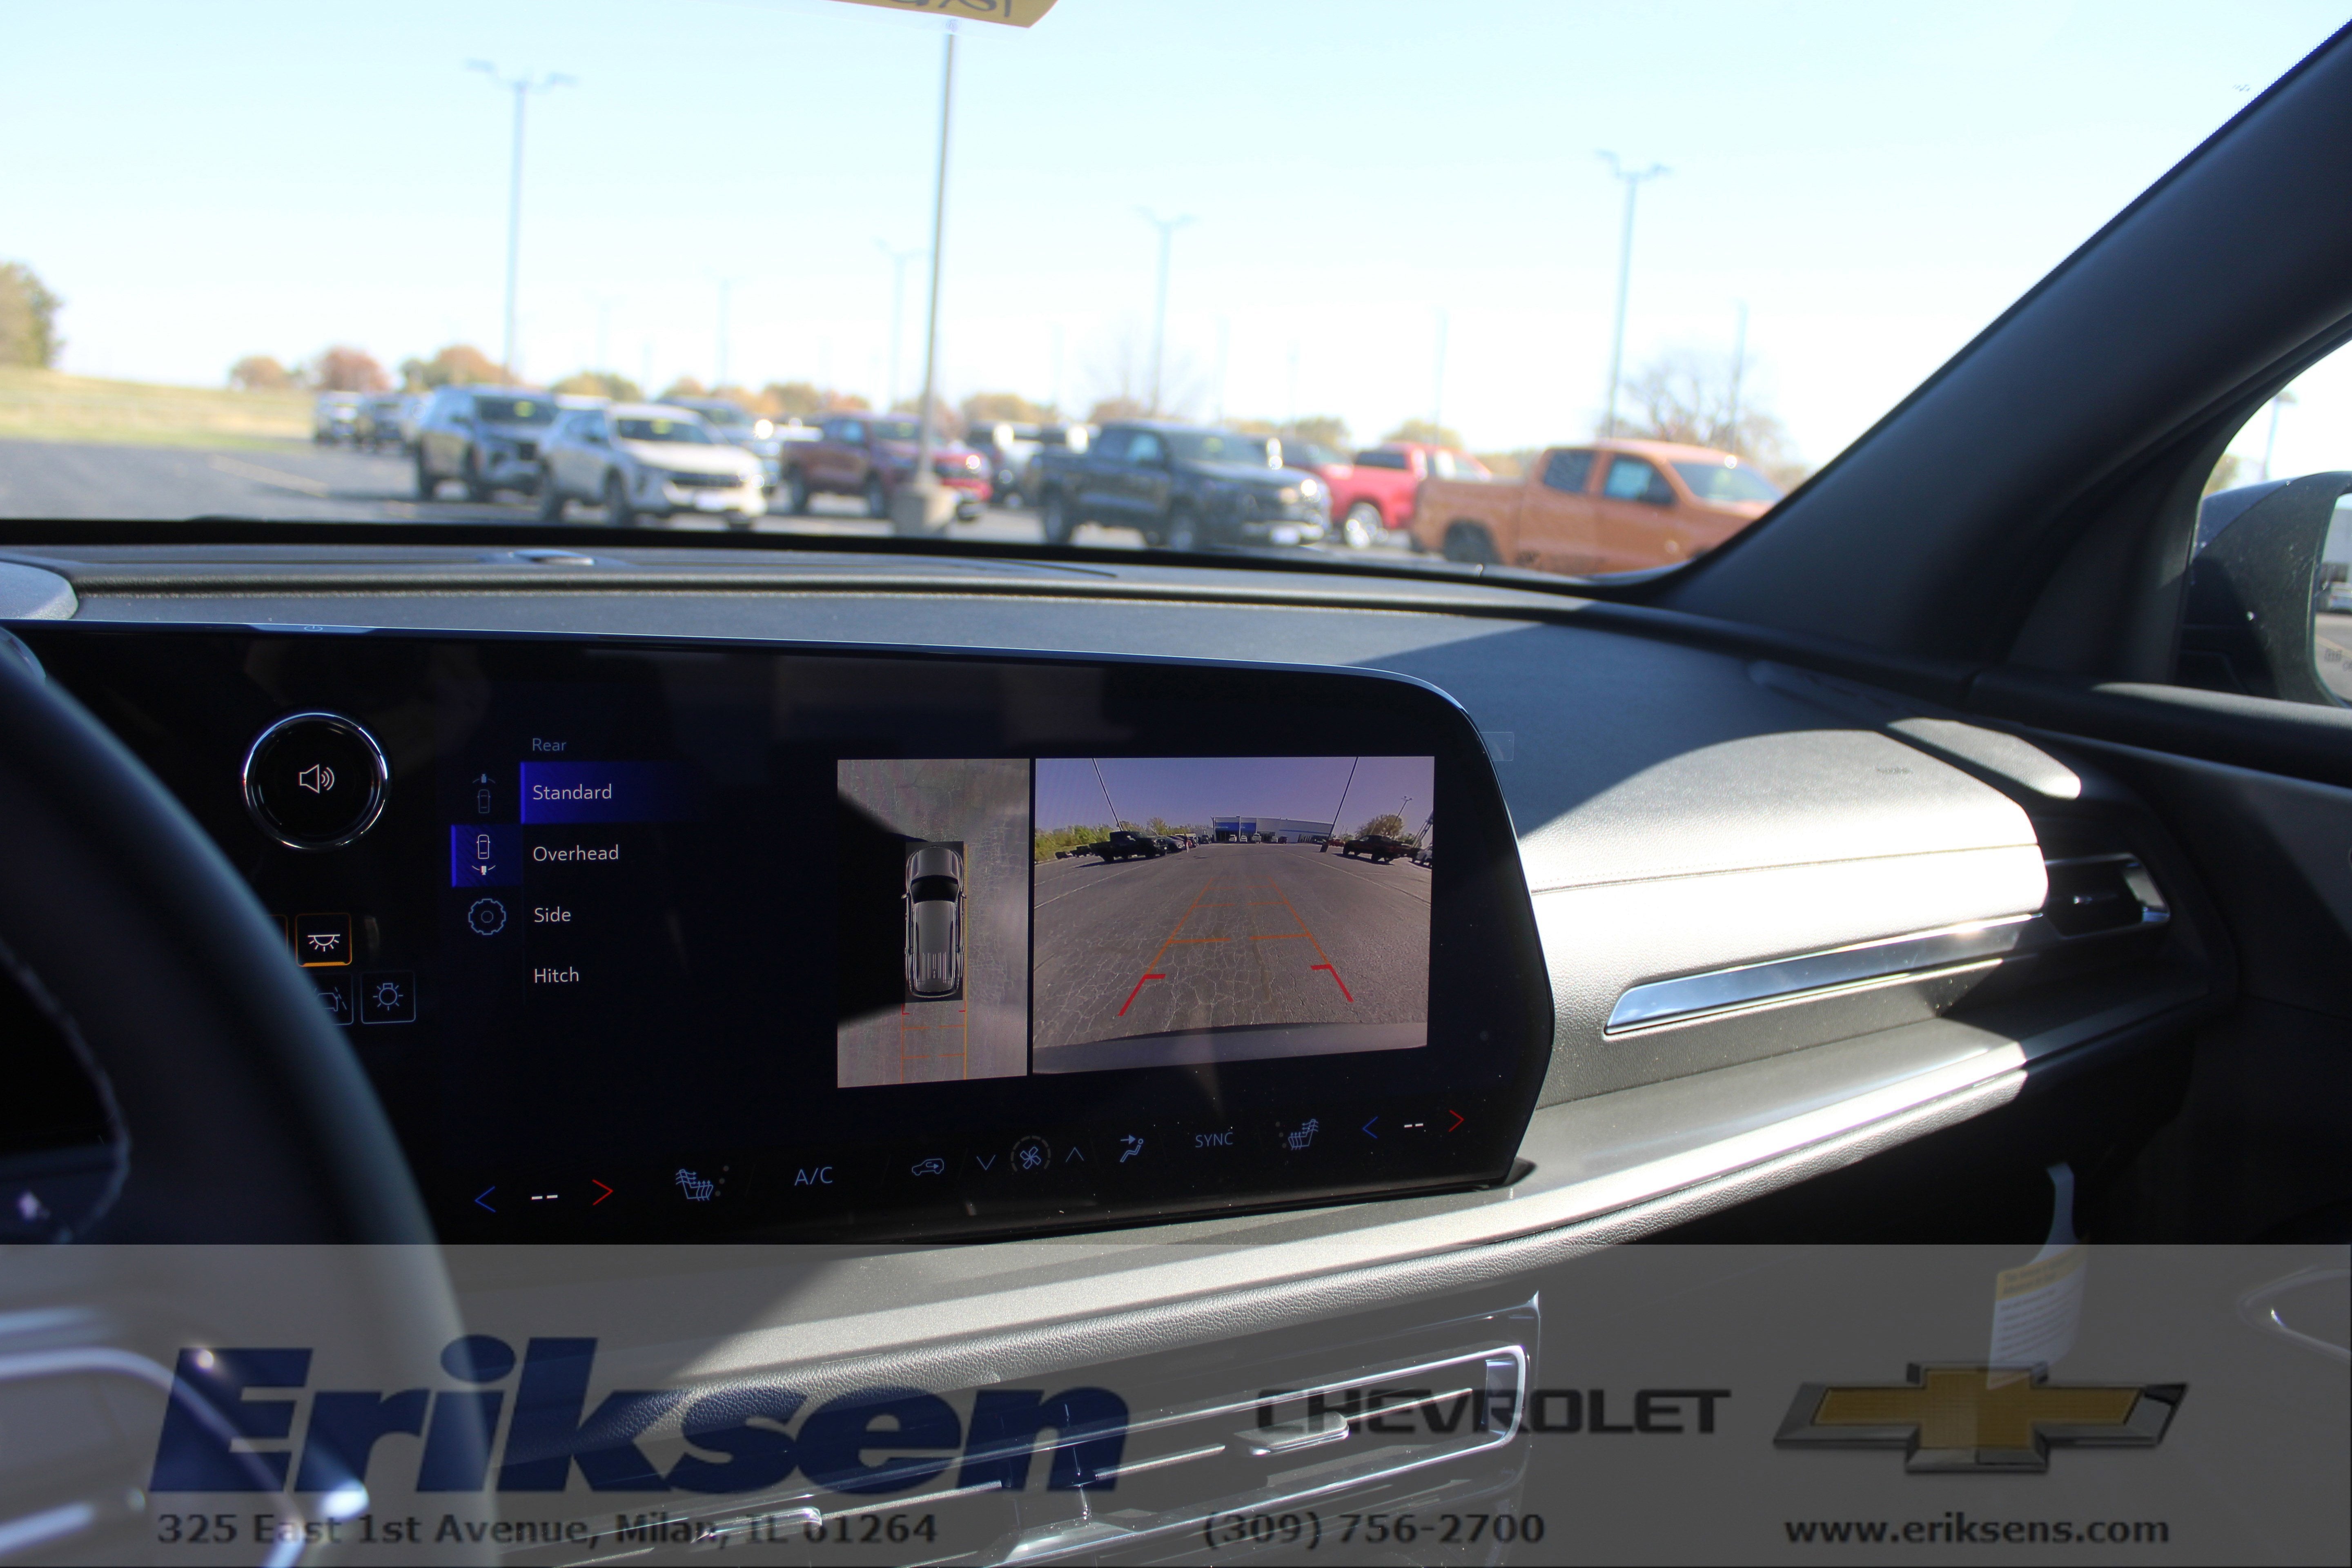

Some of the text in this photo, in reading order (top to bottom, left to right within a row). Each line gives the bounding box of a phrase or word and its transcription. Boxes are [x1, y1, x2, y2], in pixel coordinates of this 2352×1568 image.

[532, 738, 567, 752] Rear
[532, 783, 612, 800] Standard
[533, 844, 619, 862] Overhead
[534, 906, 572, 923] Side
[534, 966, 579, 984] Hitch
[1195, 1132, 1234, 1148] SYNC
[794, 1166, 833, 1186] A/C
